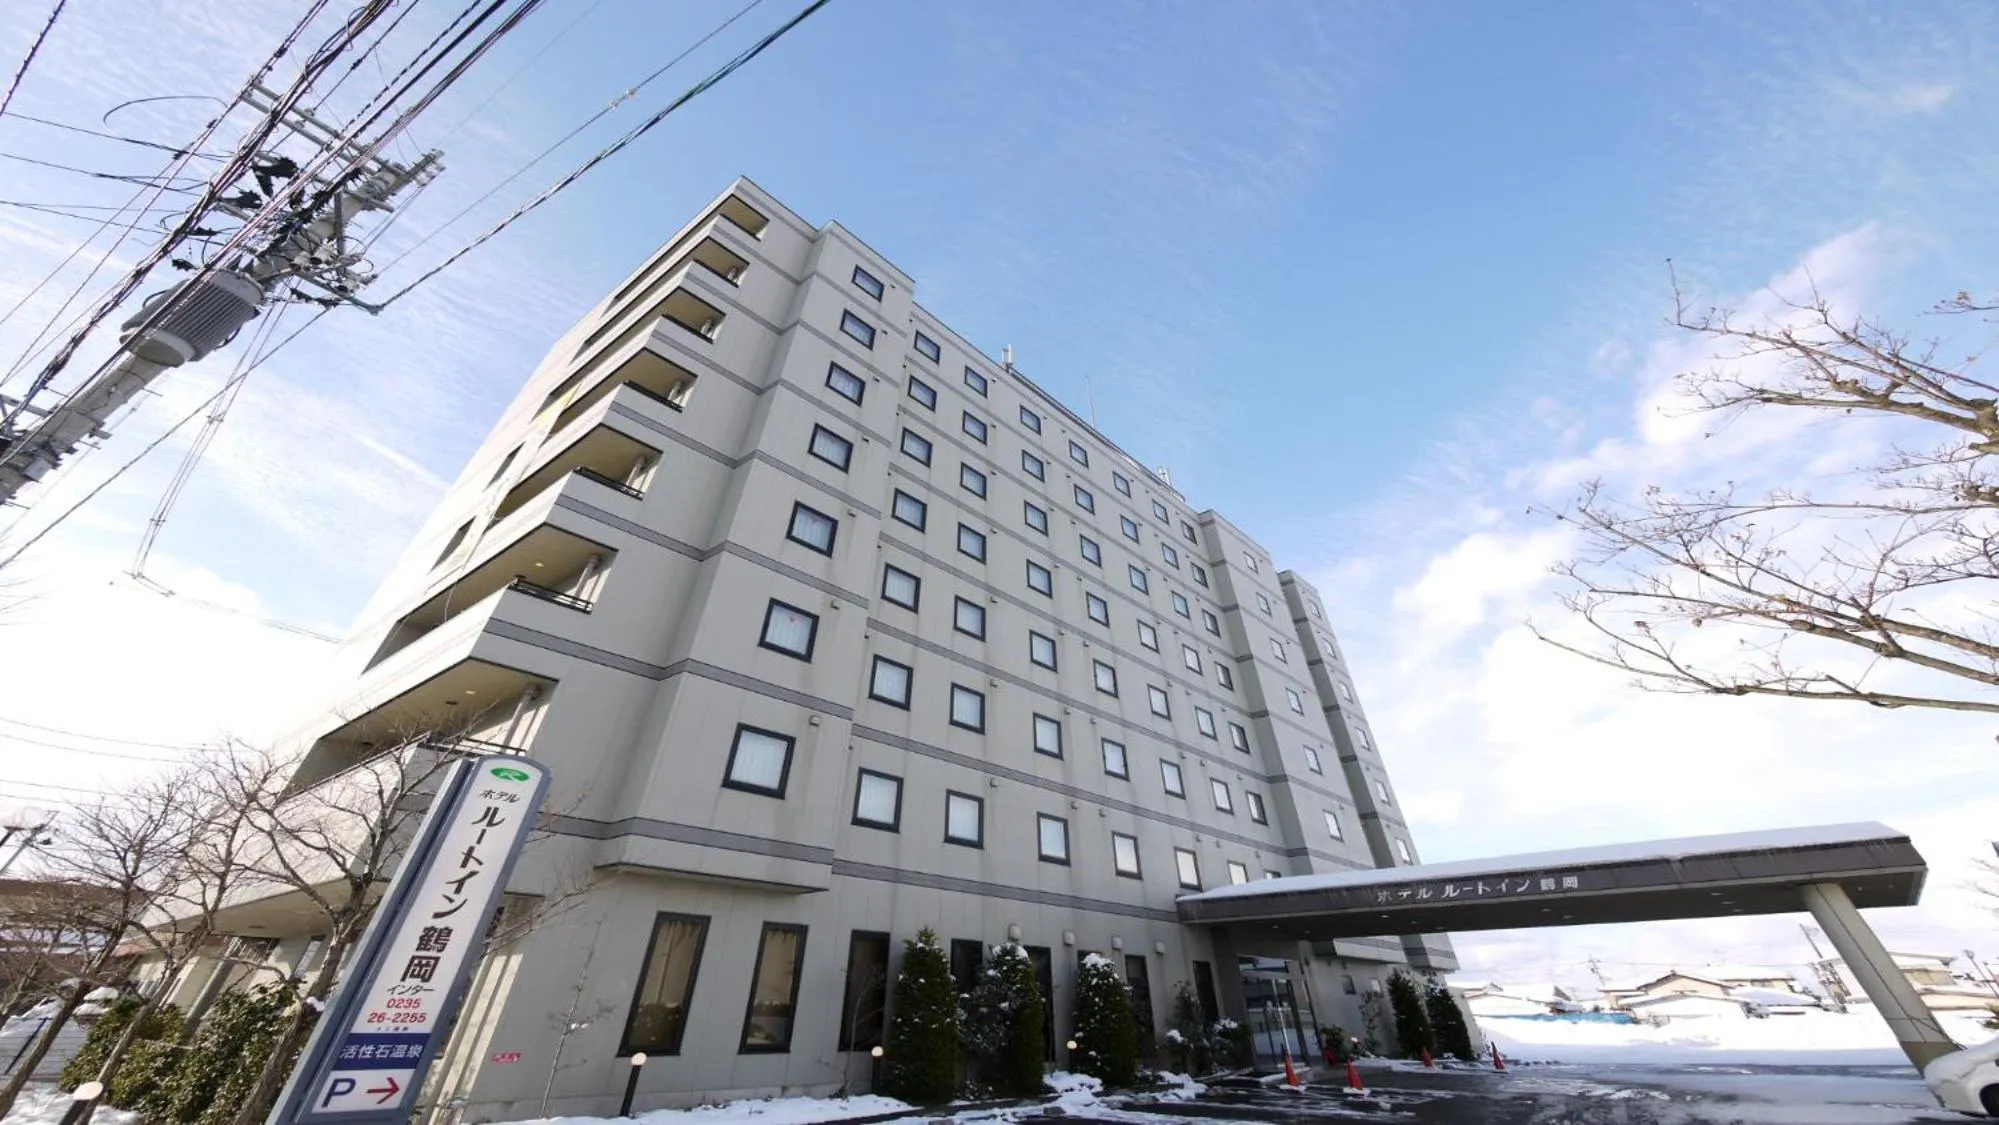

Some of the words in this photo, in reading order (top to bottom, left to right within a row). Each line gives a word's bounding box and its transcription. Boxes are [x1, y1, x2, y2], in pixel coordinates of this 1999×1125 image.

[479, 789, 520, 803] ホテル
[386, 984, 434, 996] インター
[386, 997, 422, 1009] 0235
[367, 1012, 427, 1024] 26-2255
[340, 1044, 423, 1059] 活性石温泉
[321, 1077, 356, 1108] P
